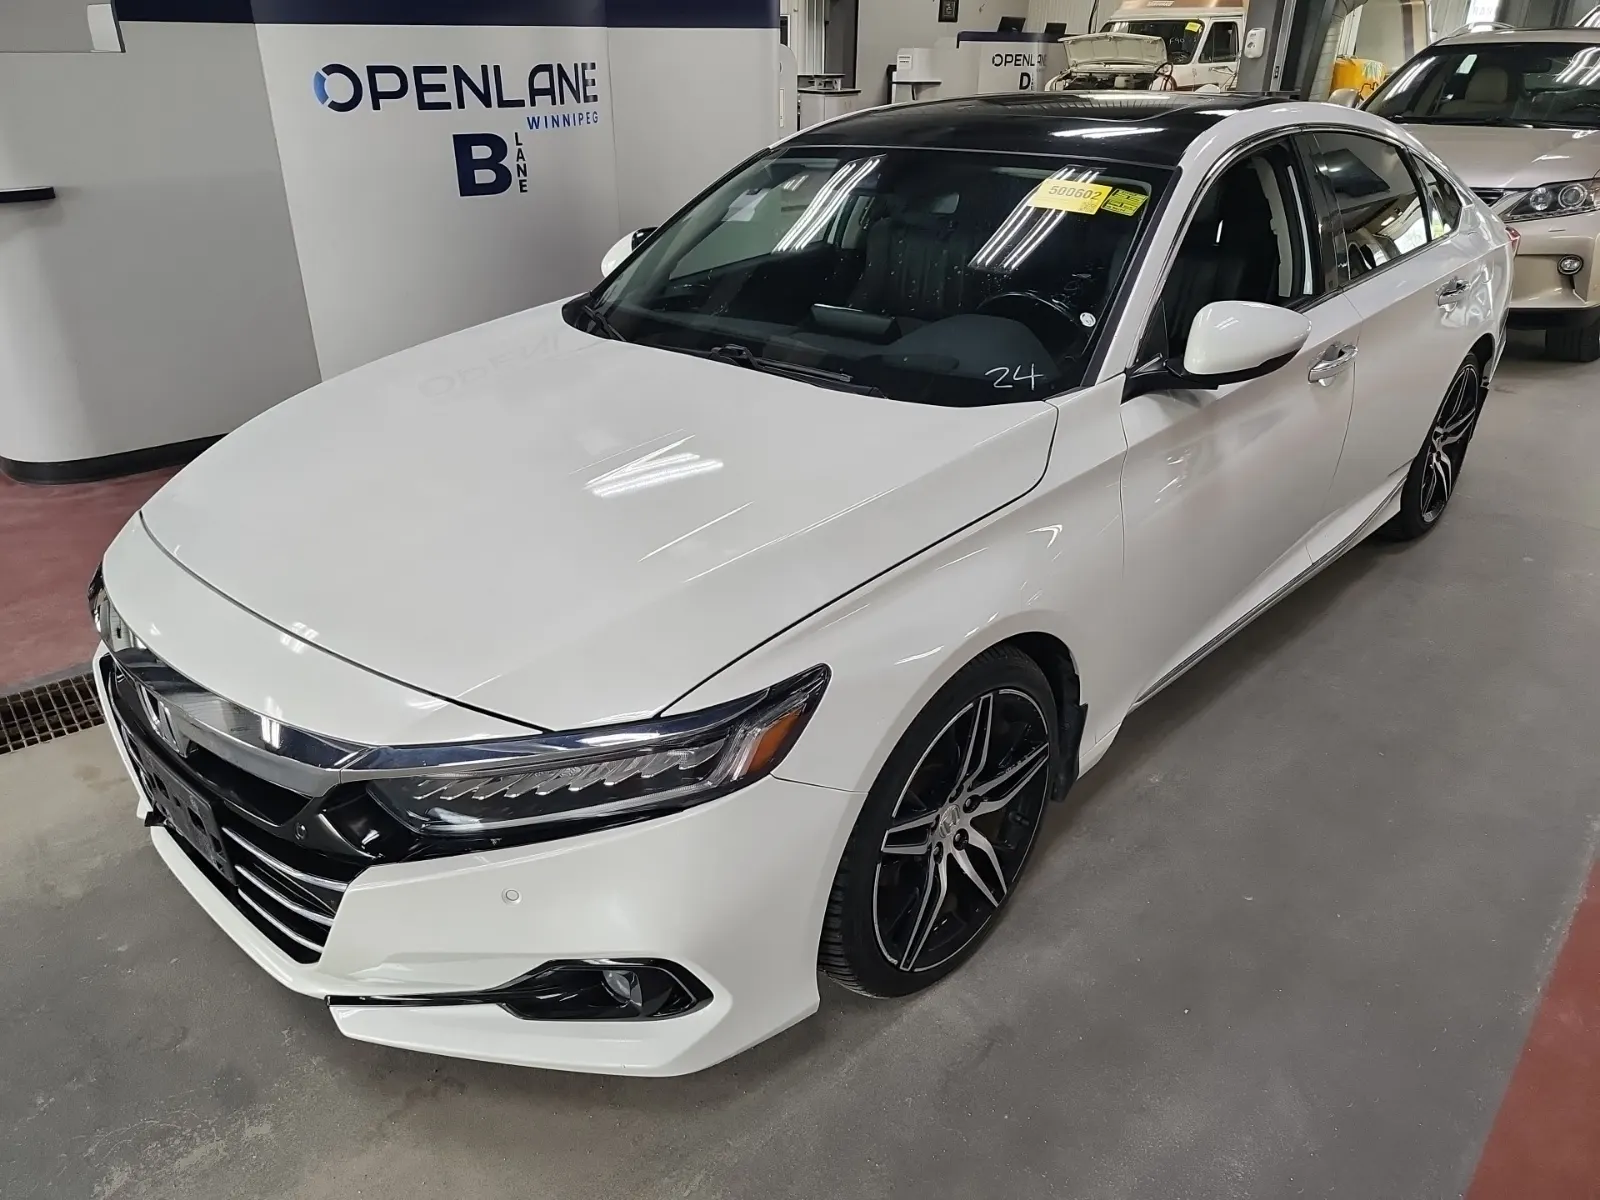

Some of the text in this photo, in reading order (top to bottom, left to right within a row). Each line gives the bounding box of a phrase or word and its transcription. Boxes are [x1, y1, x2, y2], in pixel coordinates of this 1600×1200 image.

[314, 62, 597, 112] OPENLANE
[1019, 72, 1031, 91] D
[527, 110, 599, 130] WINNIPEG
[452, 131, 528, 197] B LANE
[1048, 185, 1103, 201] 500602
[985, 363, 1044, 390] 24
